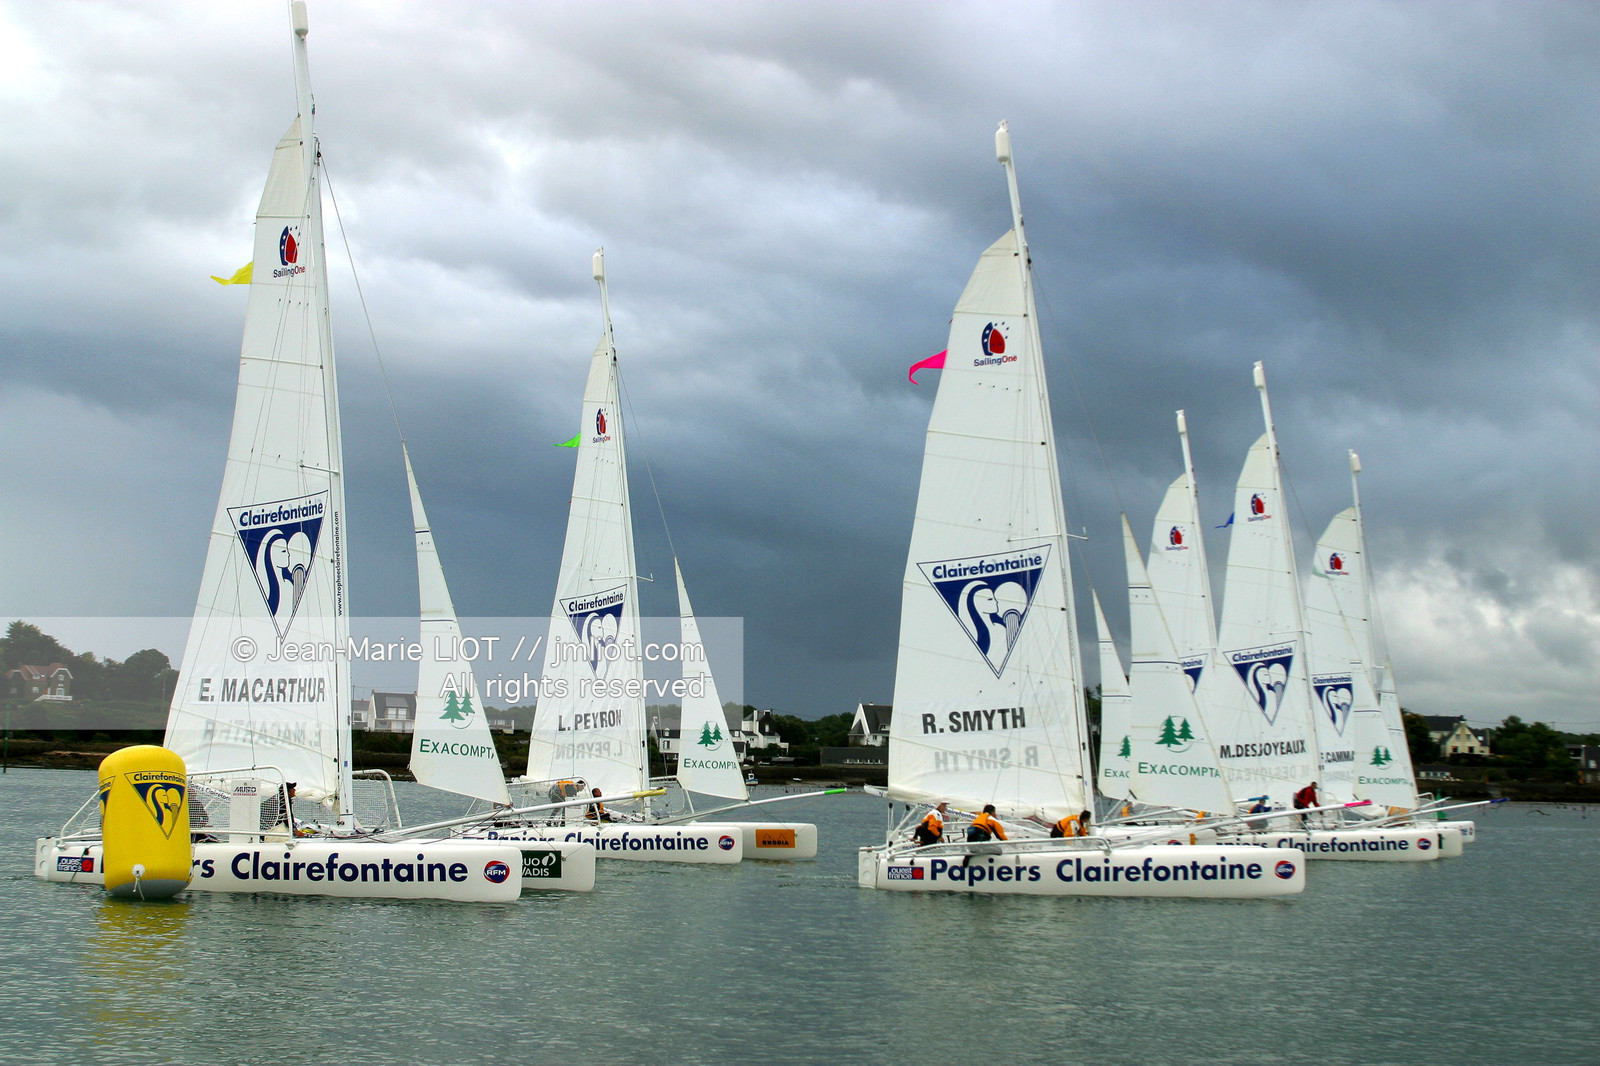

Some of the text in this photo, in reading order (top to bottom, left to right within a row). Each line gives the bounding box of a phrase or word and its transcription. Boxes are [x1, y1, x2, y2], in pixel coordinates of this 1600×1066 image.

[273, 266, 305, 278] SailingOne
[974, 355, 1017, 367] SailingOne
[239, 501, 323, 527] Clairefontaine
[334, 511, 343, 616] www.tropheeclairefontaine.com
[932, 554, 1043, 579] Clairefontaine
[568, 592, 624, 612] Clairefontaine
[1232, 645, 1293, 662] Clairefontaine
[199, 677, 325, 702] E. MACARTHUR
[558, 709, 622, 731] L. PEYRON
[922, 707, 1026, 734] R. SMYTH
[683, 758, 738, 770] EXACOMPTA
[1138, 762, 1221, 778] EXACOMPTA
[133, 772, 186, 784] Clairefontain
[565, 831, 709, 851] Clairefontaine
[1277, 836, 1409, 853] Clairefontaine
[231, 851, 468, 882] Clairefontaine
[521, 857, 540, 867] UO
[931, 855, 1263, 886] Papiers Clairefontaine
[486, 868, 507, 876] RFM
[888, 871, 912, 880] france
